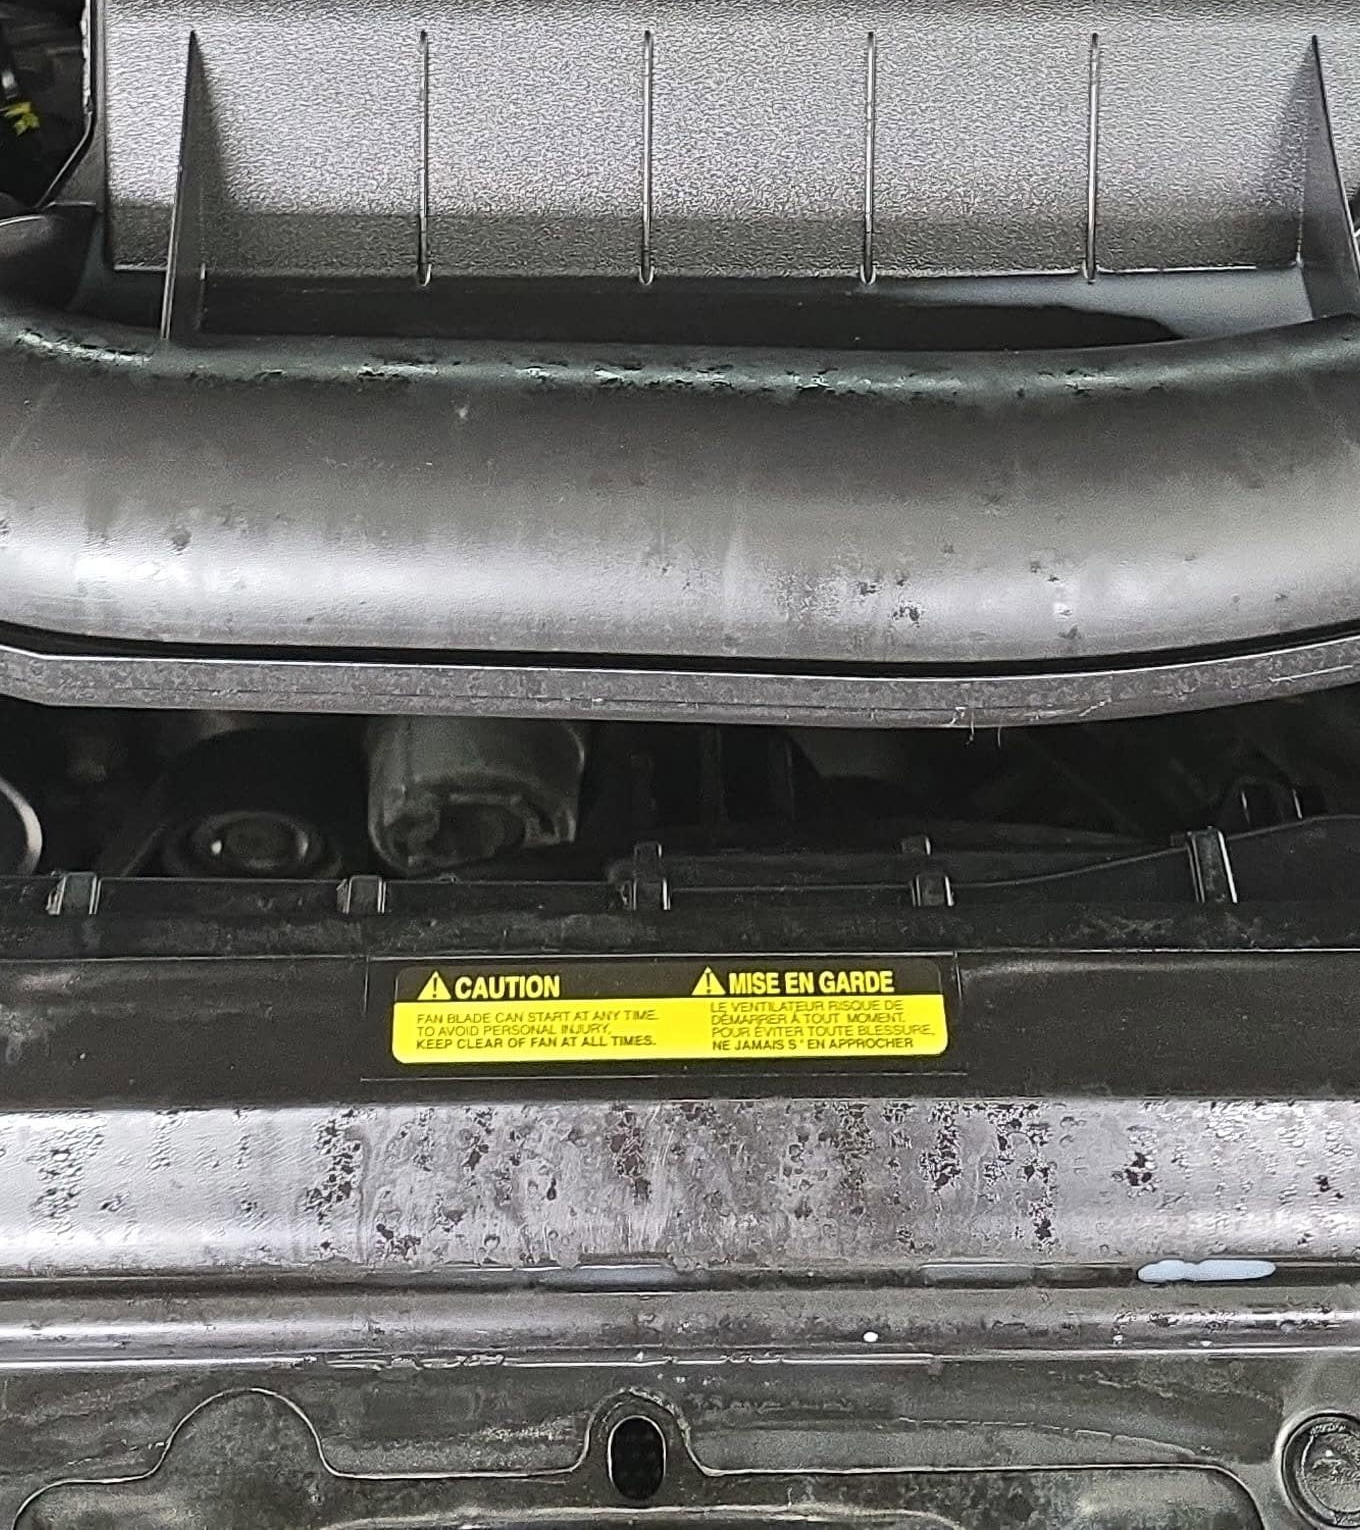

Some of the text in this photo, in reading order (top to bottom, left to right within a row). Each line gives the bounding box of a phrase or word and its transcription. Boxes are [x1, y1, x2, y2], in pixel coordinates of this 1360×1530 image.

[454, 975, 561, 1000] CAUTION
[728, 970, 895, 995] MISE EN GARDE
[710, 999, 904, 1013] LE VENTILATEUR RISQUE DE
[416, 1013, 444, 1025] FAN
[447, 1013, 490, 1024] BLADE
[495, 1012, 524, 1023] CAN
[528, 1011, 571, 1023] START
[574, 1010, 590, 1022] AT
[592, 1010, 620, 1022] ANY
[804, 1012, 840, 1024] TOUT
[417, 1026, 436, 1037] TO
[438, 1026, 480, 1037] AVOID
[482, 1024, 556, 1036] PERSONAL
[711, 1026, 751, 1038] POUR
[754, 1022, 804, 1037] ÉVITER
[808, 1025, 853, 1037] TOUTE
[416, 1035, 657, 1050] KEEP CLEAR OF FAN AT ALL TIMES.
[712, 1040, 729, 1051] NE
[734, 1039, 785, 1051] JAMAIS
[807, 1039, 826, 1050] EN
[829, 1038, 914, 1050] APPROCHER
